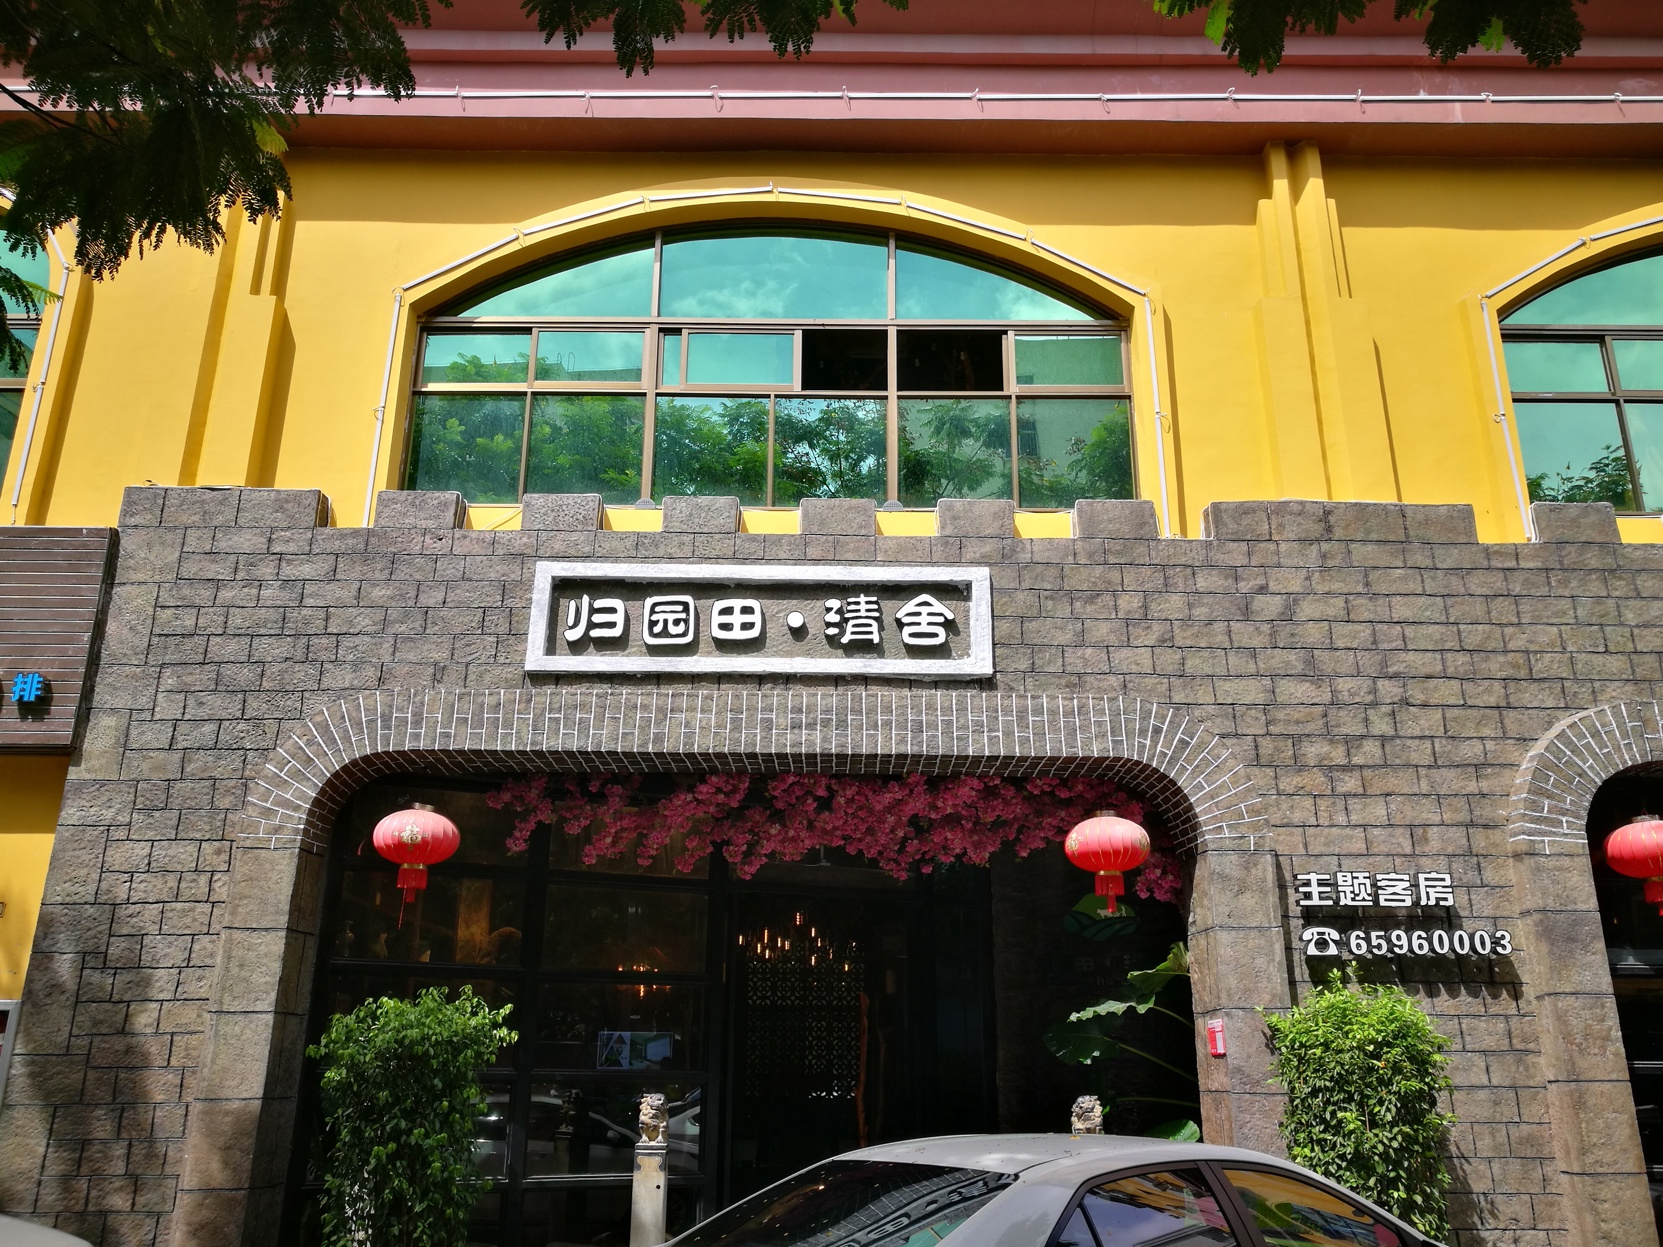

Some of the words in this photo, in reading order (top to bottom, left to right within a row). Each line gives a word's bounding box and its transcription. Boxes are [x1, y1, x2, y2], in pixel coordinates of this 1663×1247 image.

[11, 672, 44, 702] 排
[1296, 871, 1455, 907] 主题客房
[1349, 929, 1513, 955] 65960003
